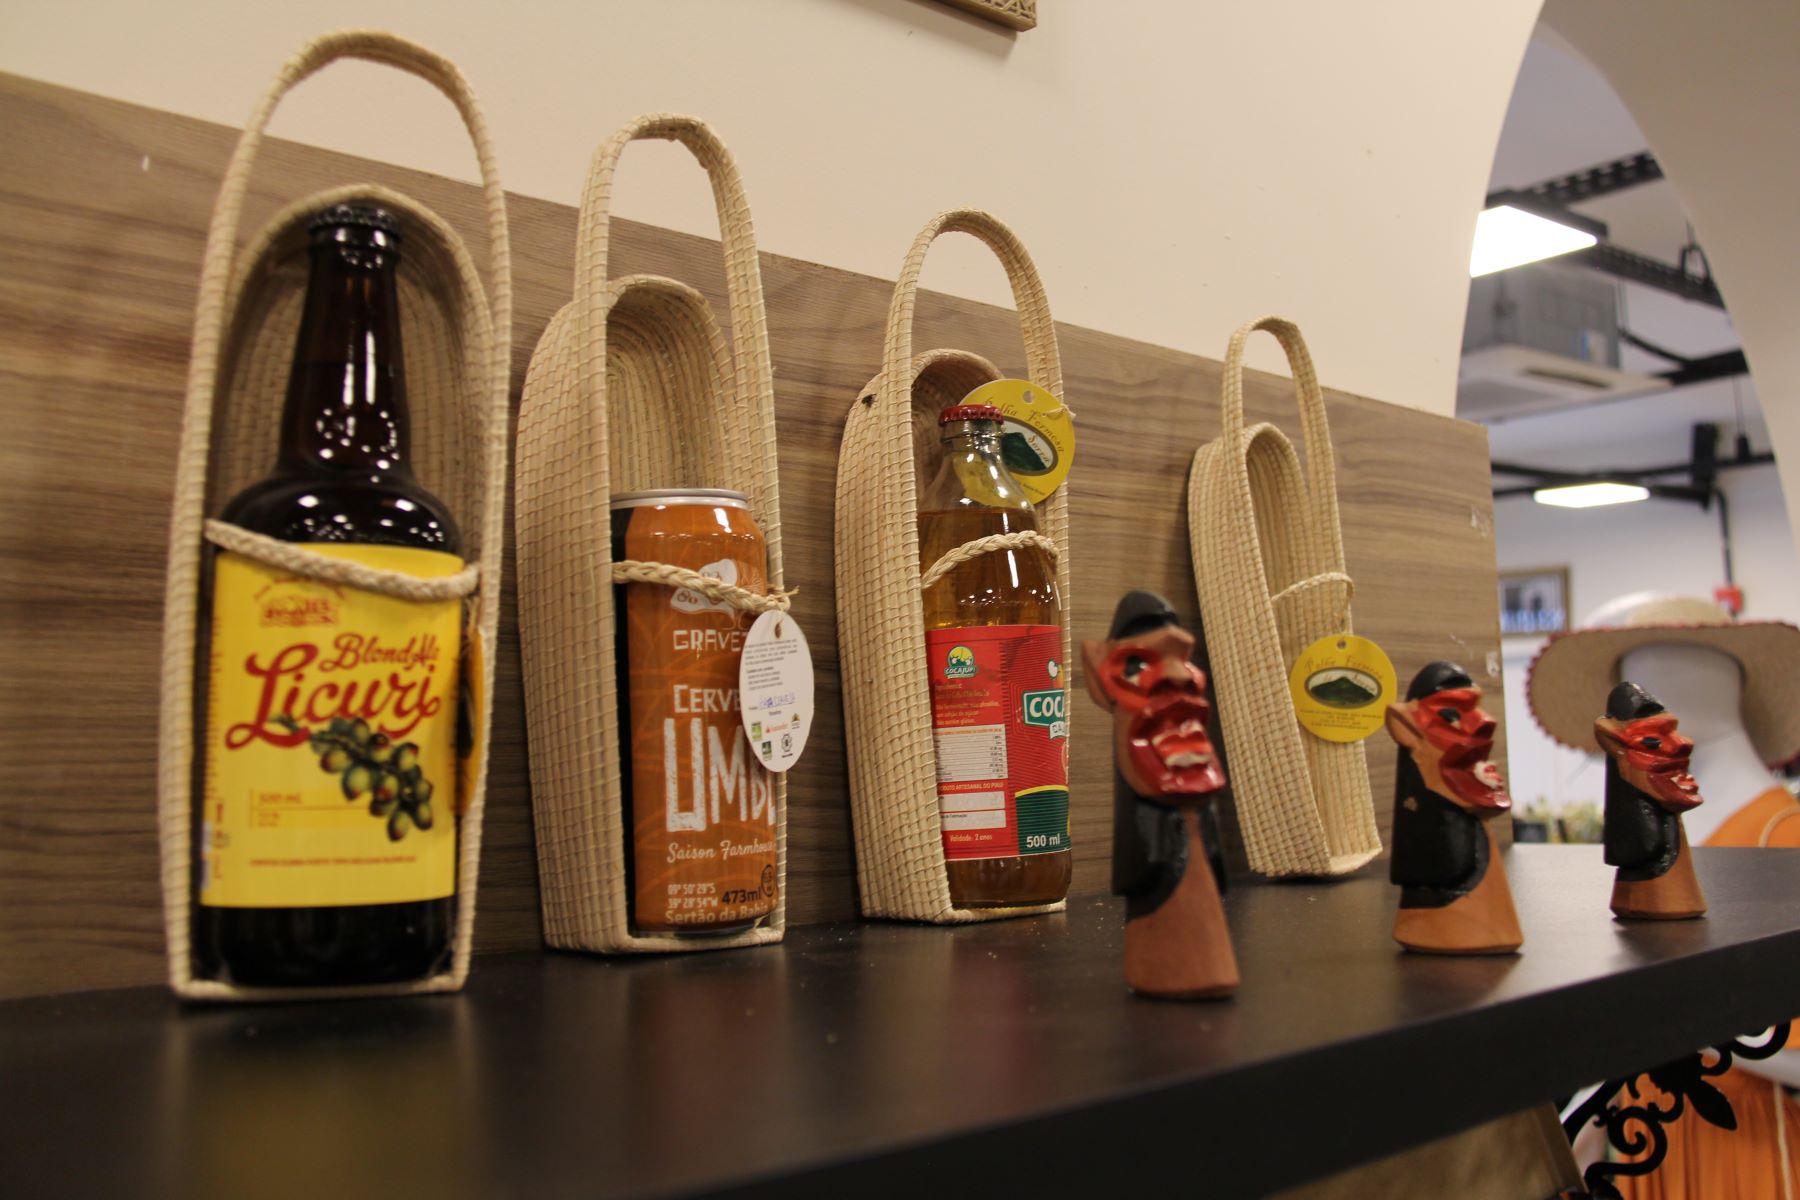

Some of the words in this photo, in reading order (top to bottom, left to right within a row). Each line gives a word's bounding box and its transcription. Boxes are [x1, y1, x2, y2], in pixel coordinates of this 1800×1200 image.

[225, 643, 441, 750] Licuri
[1030, 696, 1065, 718] COC
[1026, 835, 1047, 848] 500
[1049, 833, 1061, 846] ml
[667, 842, 717, 864] Saison
[722, 885, 763, 905] 473ml
[665, 909, 717, 924] Sertão
[719, 906, 737, 921] da
[739, 902, 769, 918] Bahia
